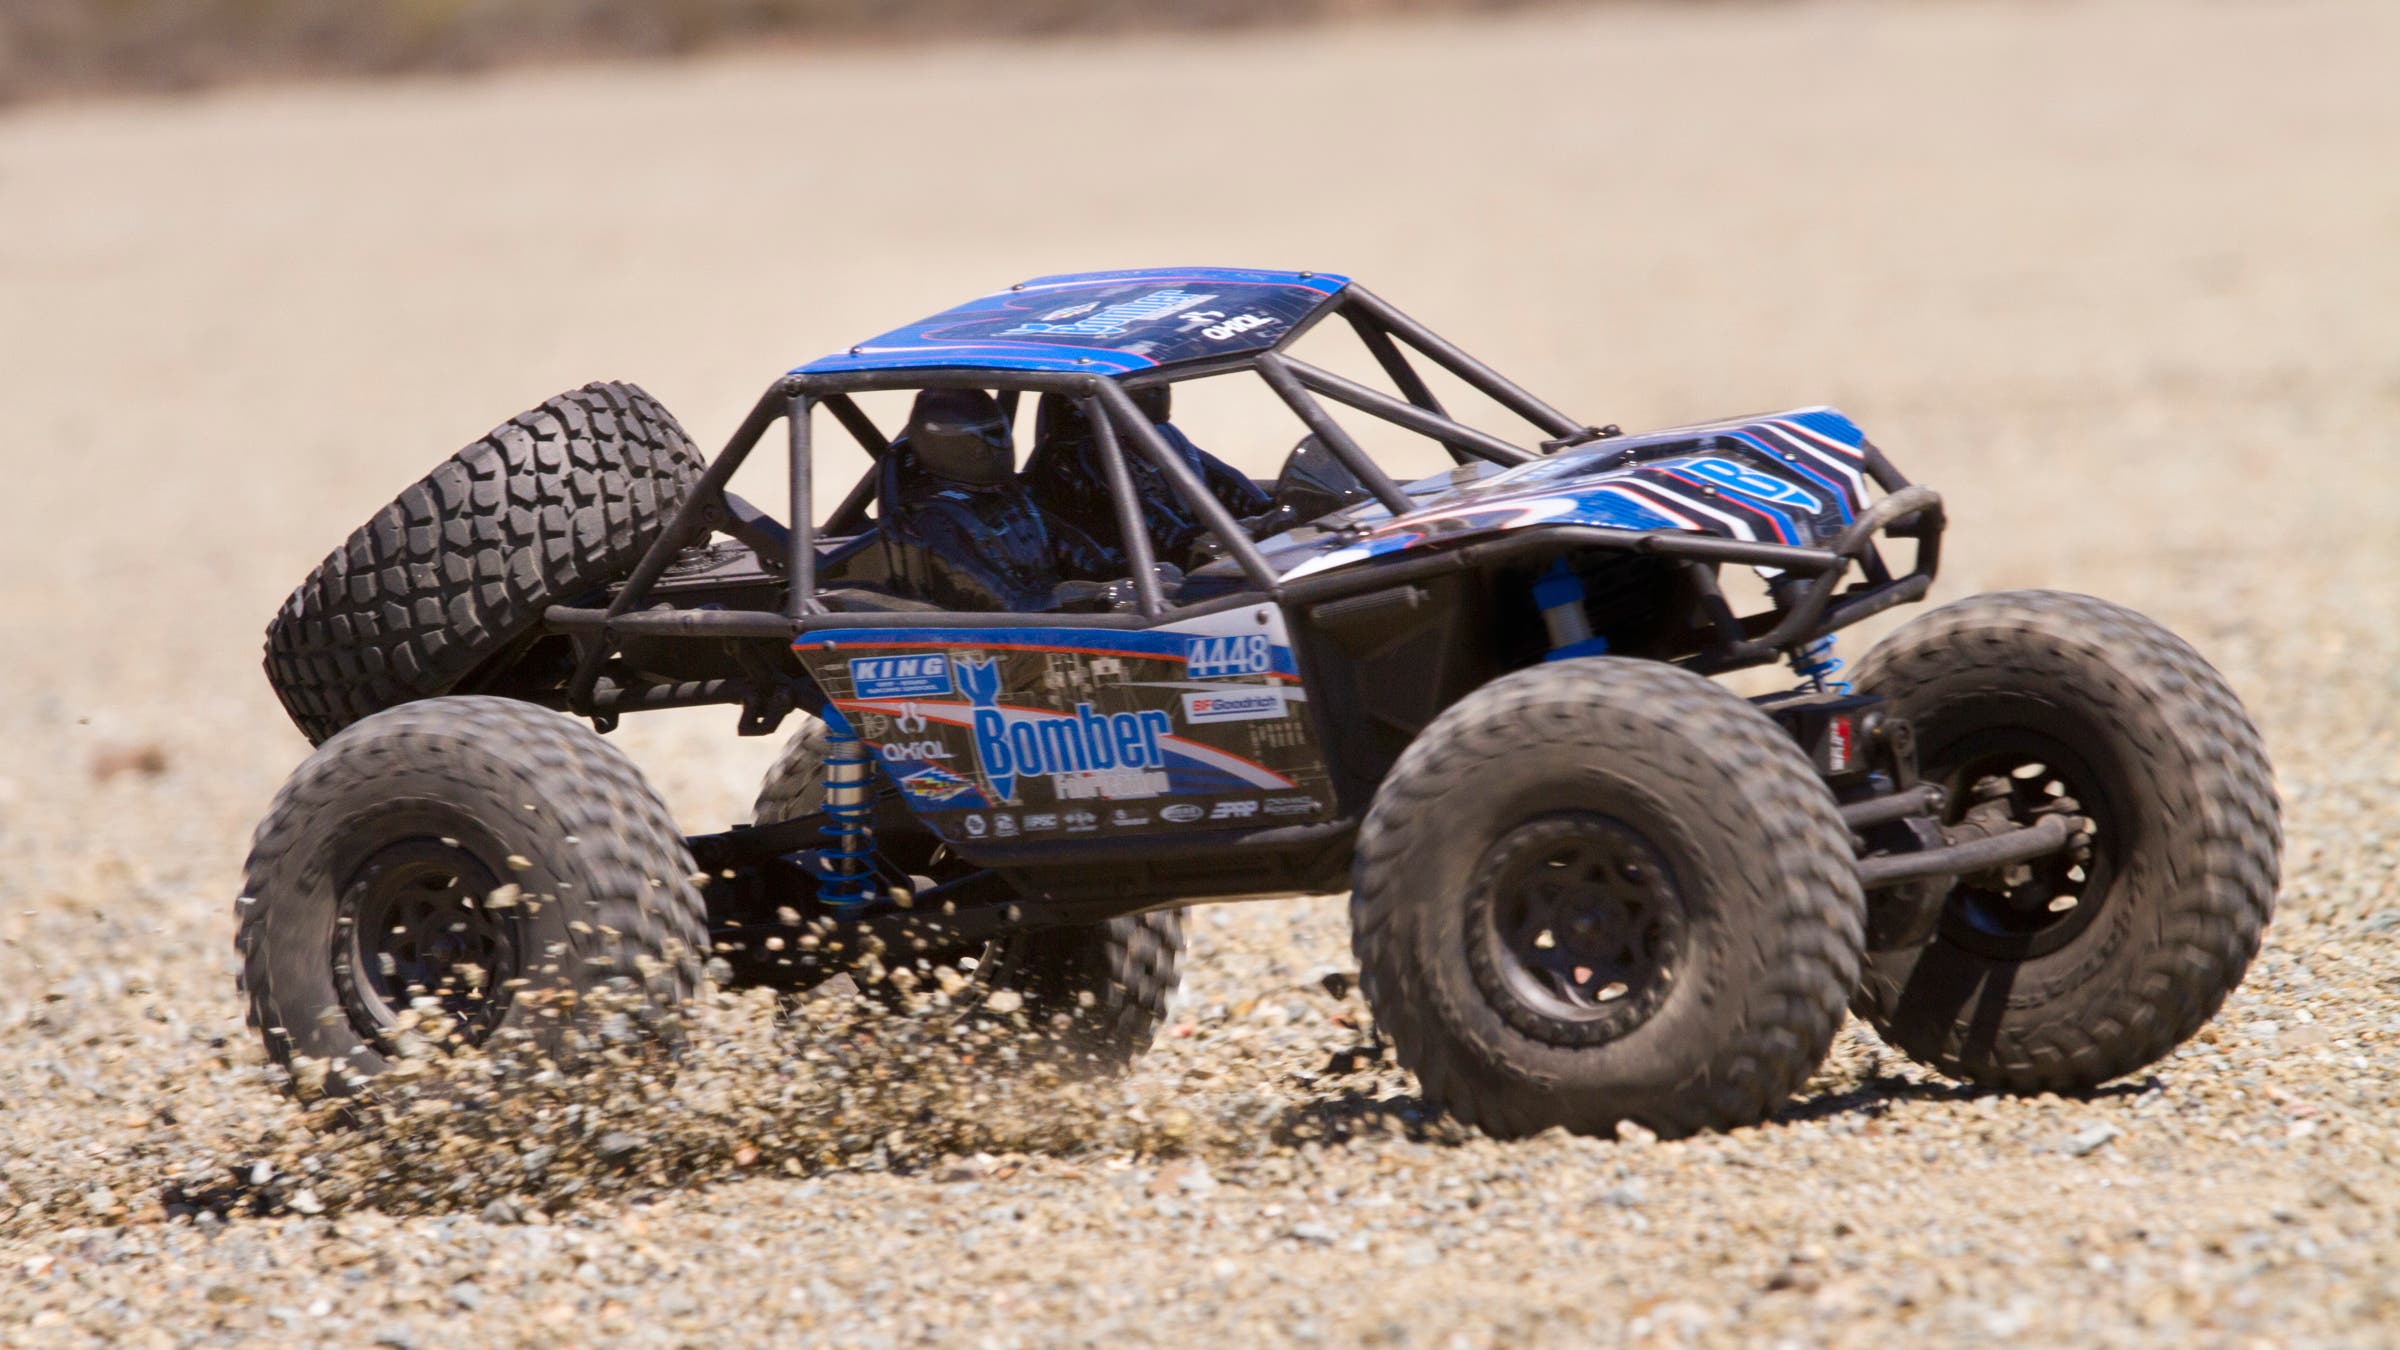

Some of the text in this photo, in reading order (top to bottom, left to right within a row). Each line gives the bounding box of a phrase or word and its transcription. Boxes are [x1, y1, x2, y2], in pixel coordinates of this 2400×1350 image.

[856, 657, 945, 680] KING
[1187, 636, 1270, 675] 4448
[1192, 696, 1277, 712] BFGoodrich
[974, 703, 1172, 779] Bomber
